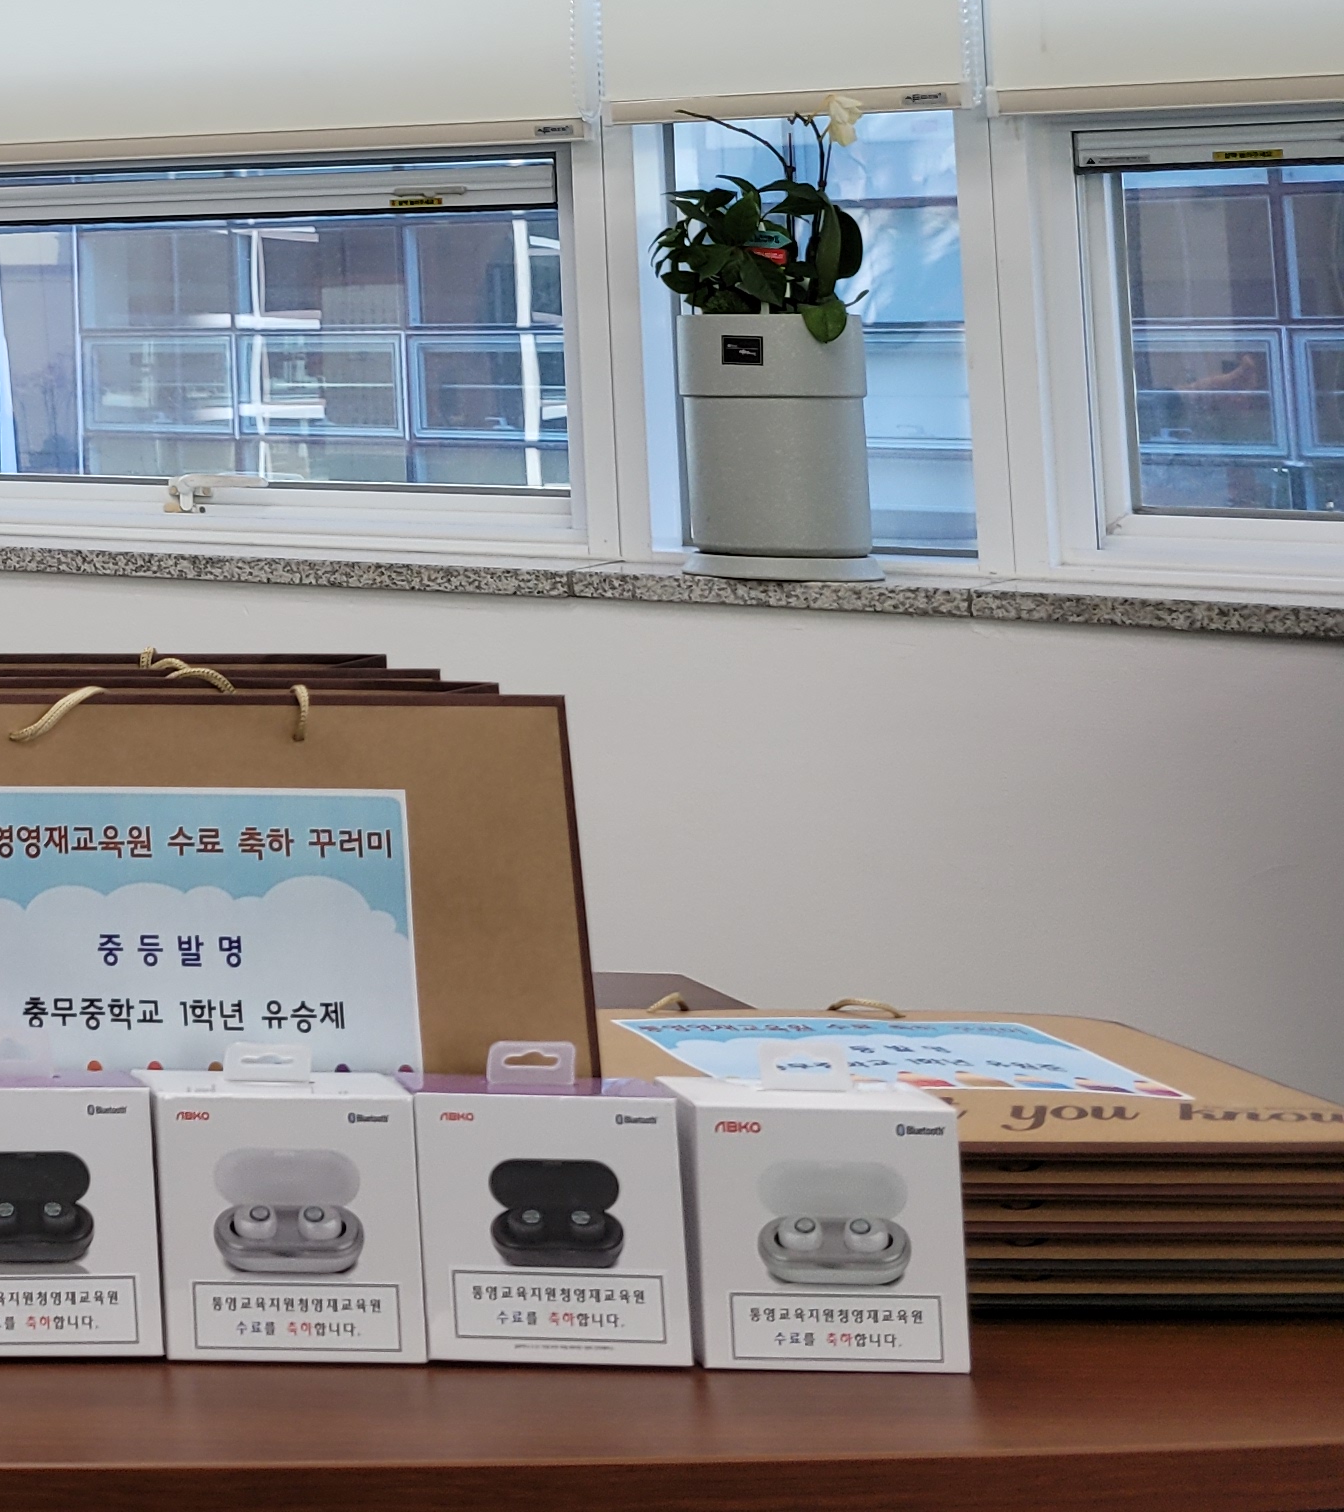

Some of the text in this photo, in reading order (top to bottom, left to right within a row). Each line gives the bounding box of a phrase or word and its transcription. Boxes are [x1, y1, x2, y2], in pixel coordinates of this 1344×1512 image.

[167, 825, 224, 858] 수료
[237, 827, 295, 861] 축하
[307, 827, 393, 860] 꾸러미
[22, 995, 346, 1034] 충무중학교 1학년 유승제
[175, 1111, 210, 1121] ABKO
[439, 1111, 475, 1122] ABKO
[1001, 1104, 1140, 1133] you
[714, 1120, 762, 1134] ABKO
[472, 1285, 645, 1305] 통영교육지원청영재교육원
[212, 1296, 382, 1314] 통영교육지원청영재교육원
[25, 1315, 100, 1331] 축하합니다.
[496, 1310, 626, 1329] 수료를 축하합니다.
[749, 1307, 923, 1325] 통영교육지원청영재교육원
[236, 1320, 362, 1337] 수료를 축하합니다.
[774, 1331, 903, 1348] 수료를 축하합니다.
